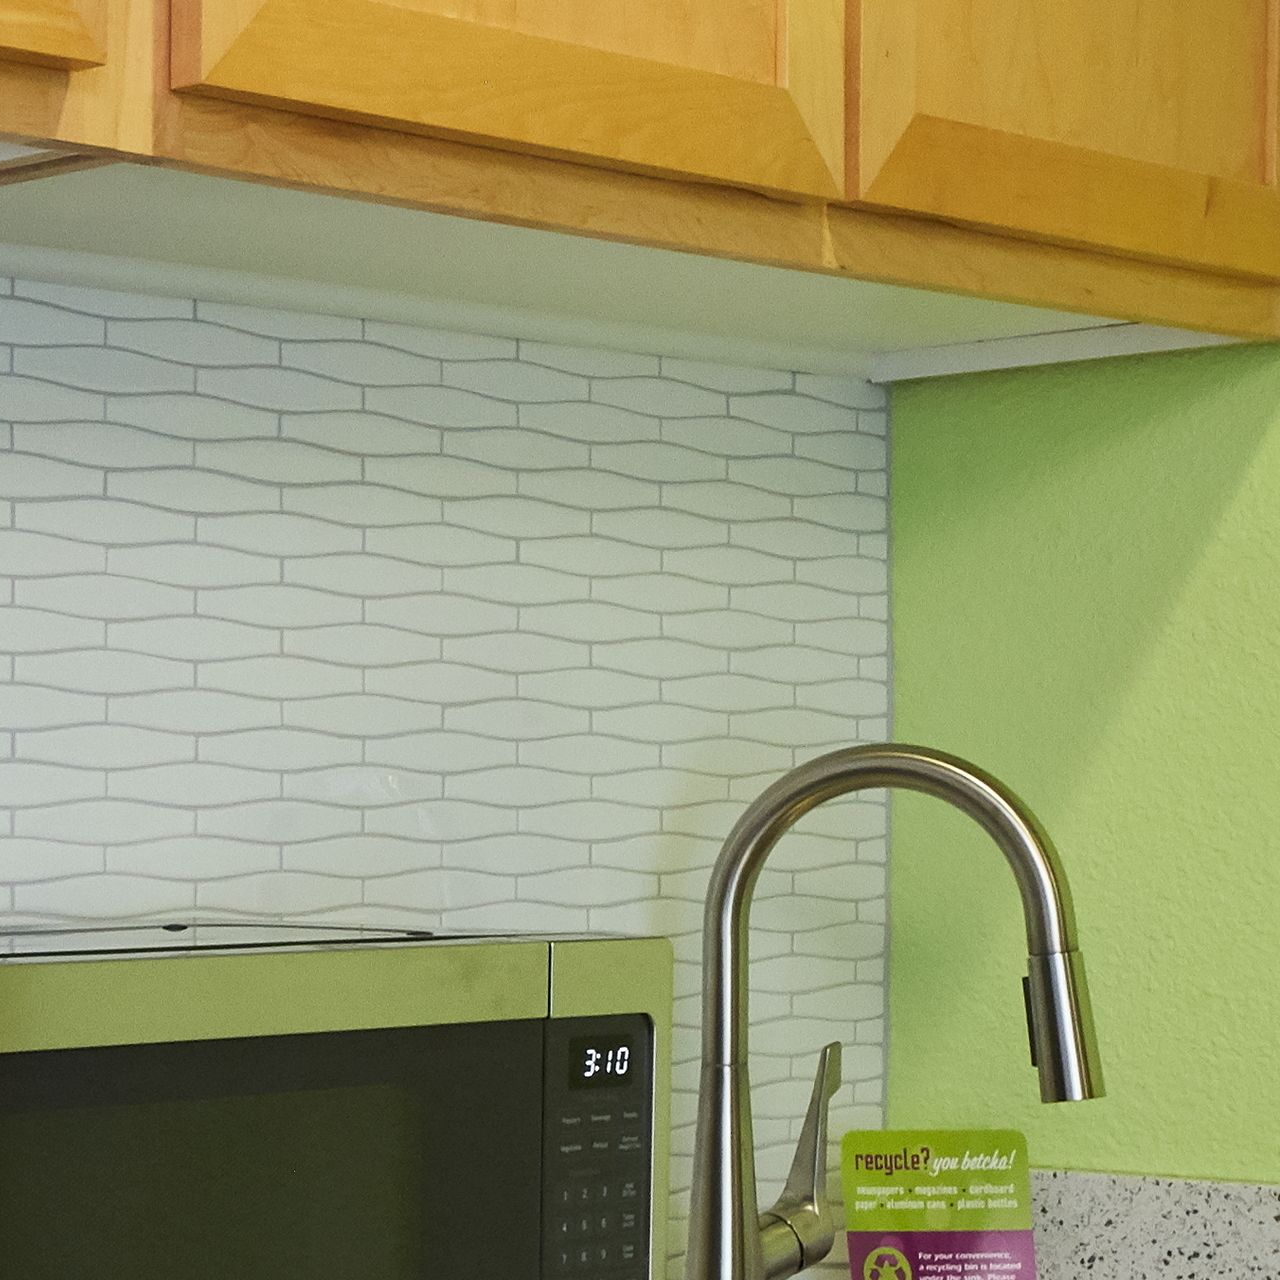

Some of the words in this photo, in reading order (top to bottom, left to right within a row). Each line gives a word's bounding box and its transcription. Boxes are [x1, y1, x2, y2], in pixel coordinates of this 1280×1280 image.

[584, 1046, 629, 1077] 3:10
[855, 1147, 930, 1175] recycle?
[929, 1156, 959, 1177] you
[961, 1149, 1017, 1170] betcha!
[914, 1185, 958, 1196] magazines
[969, 1183, 1015, 1194] cardboard
[886, 1199, 925, 1209] aluminum
[927, 1200, 946, 1209] cans
[957, 1199, 986, 1211] plastic
[988, 1198, 1019, 1209] bottles
[918, 1252, 932, 1260] For
[934, 1253, 954, 1263] your
[926, 1263, 962, 1273] recycling
[964, 1263, 978, 1271] bin
[980, 1263, 988, 1271] is
[989, 1262, 1022, 1271] located
